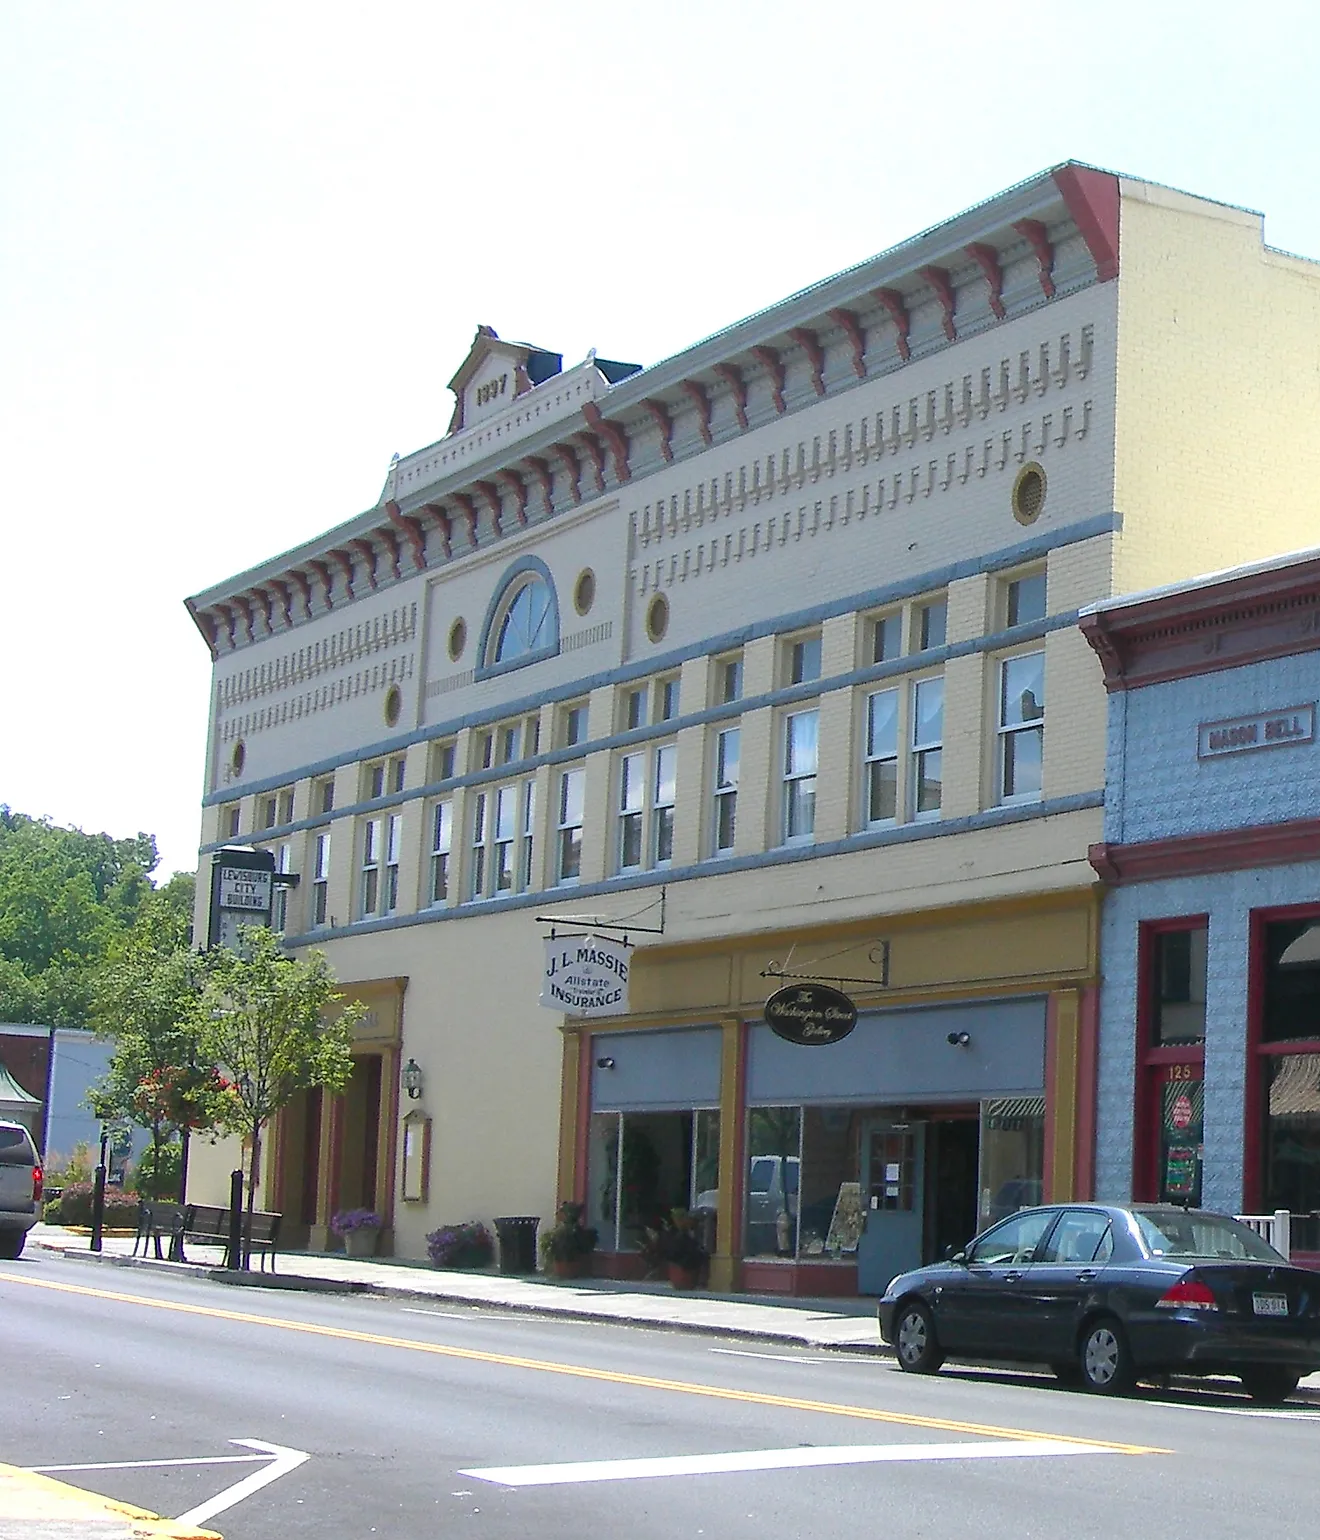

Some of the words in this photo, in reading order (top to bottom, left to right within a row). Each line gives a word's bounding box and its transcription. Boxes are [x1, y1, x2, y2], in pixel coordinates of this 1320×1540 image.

[223, 869, 268, 883] LEWISBURG
[234, 883, 257, 893] CITY
[227, 893, 263, 907] BUILDING
[546, 957, 559, 977] J.
[562, 952, 574, 968] L.
[576, 948, 629, 983] MASSIE
[564, 975, 610, 988] Allstate
[551, 983, 623, 1008] INSURANCE
